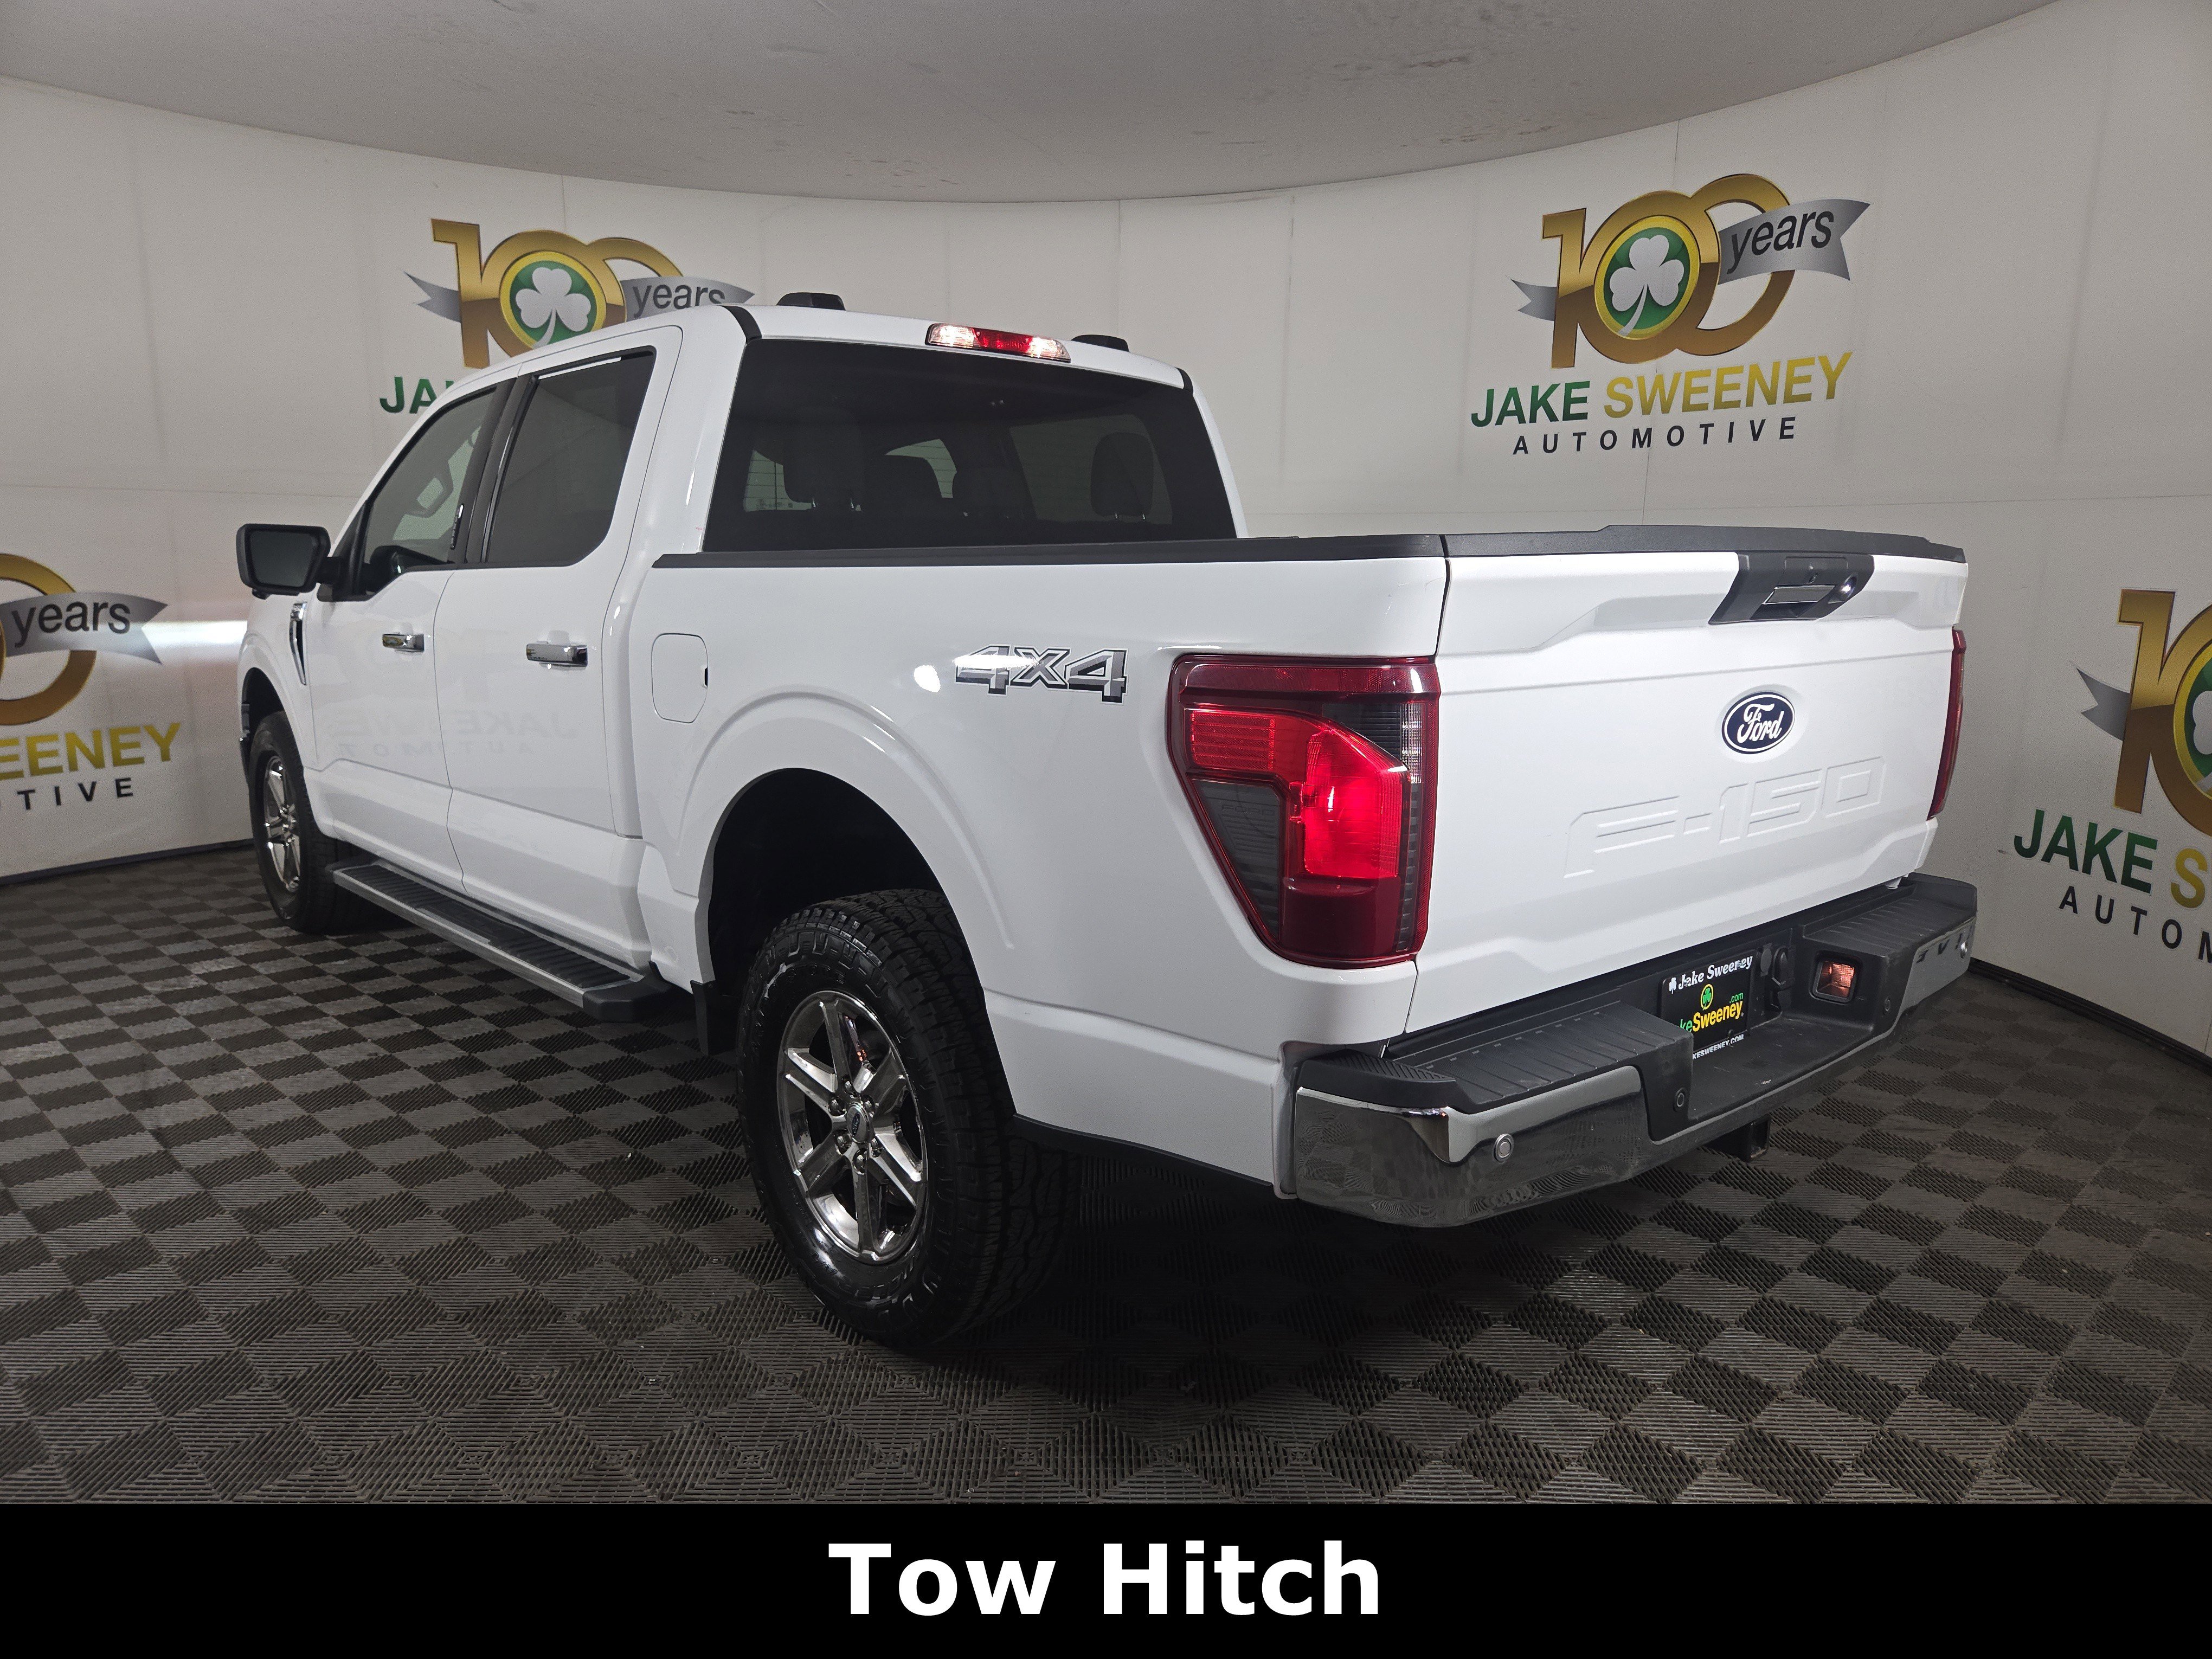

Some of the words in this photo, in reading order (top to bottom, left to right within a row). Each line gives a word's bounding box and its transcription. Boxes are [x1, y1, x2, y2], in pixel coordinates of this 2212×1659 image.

[1542, 173, 1796, 369] 100
[1727, 210, 1835, 274] years
[633, 284, 725, 318] years
[380, 376, 454, 414] JA
[1471, 381, 1591, 428] JAKE
[1604, 352, 1853, 419] SWEENEY
[1513, 417, 1797, 455] AUTOMOTIVE
[12, 601, 131, 647] years
[1737, 703, 1785, 743] Ford
[17, 777, 133, 810] TIVE
[1562, 756, 1887, 879] F-150
[2014, 809, 2158, 893] JAKE
[1678, 970, 1705, 989] Jake
[1729, 993, 1744, 1004] .com
